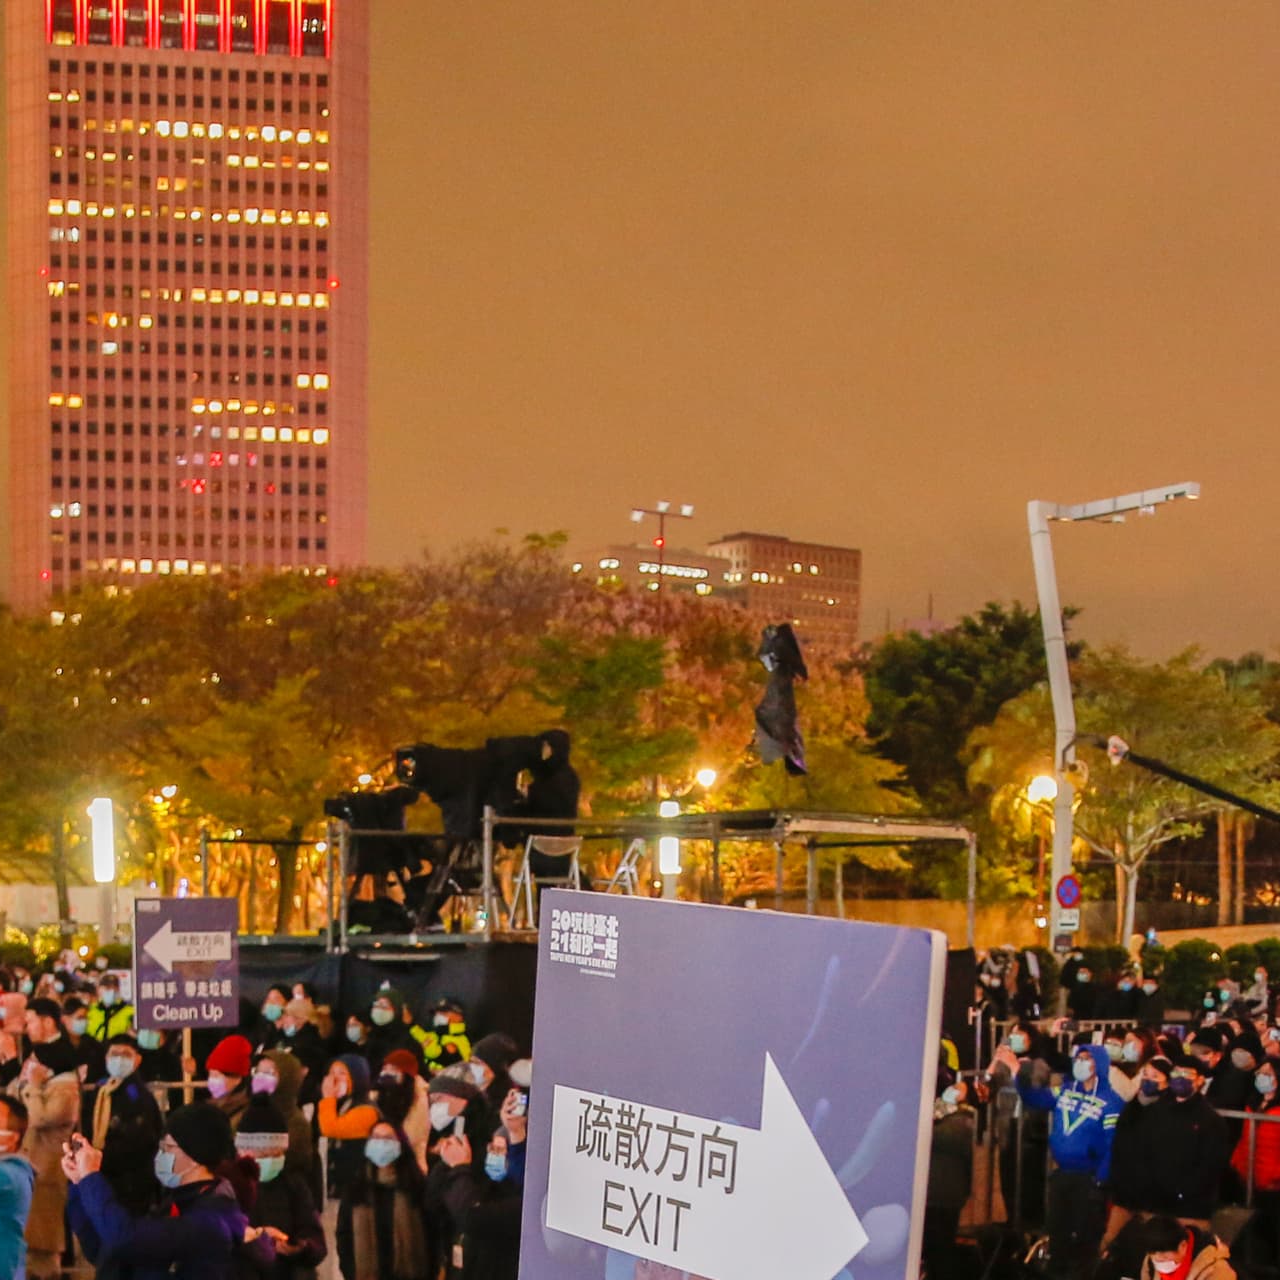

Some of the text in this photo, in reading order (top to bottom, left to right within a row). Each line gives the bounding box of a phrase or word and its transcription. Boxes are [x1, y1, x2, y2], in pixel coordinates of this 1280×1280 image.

[152, 1003, 224, 1022] Clean Up
[575, 1098, 739, 1195] 疏散方向
[601, 1180, 691, 1253] EXIT
